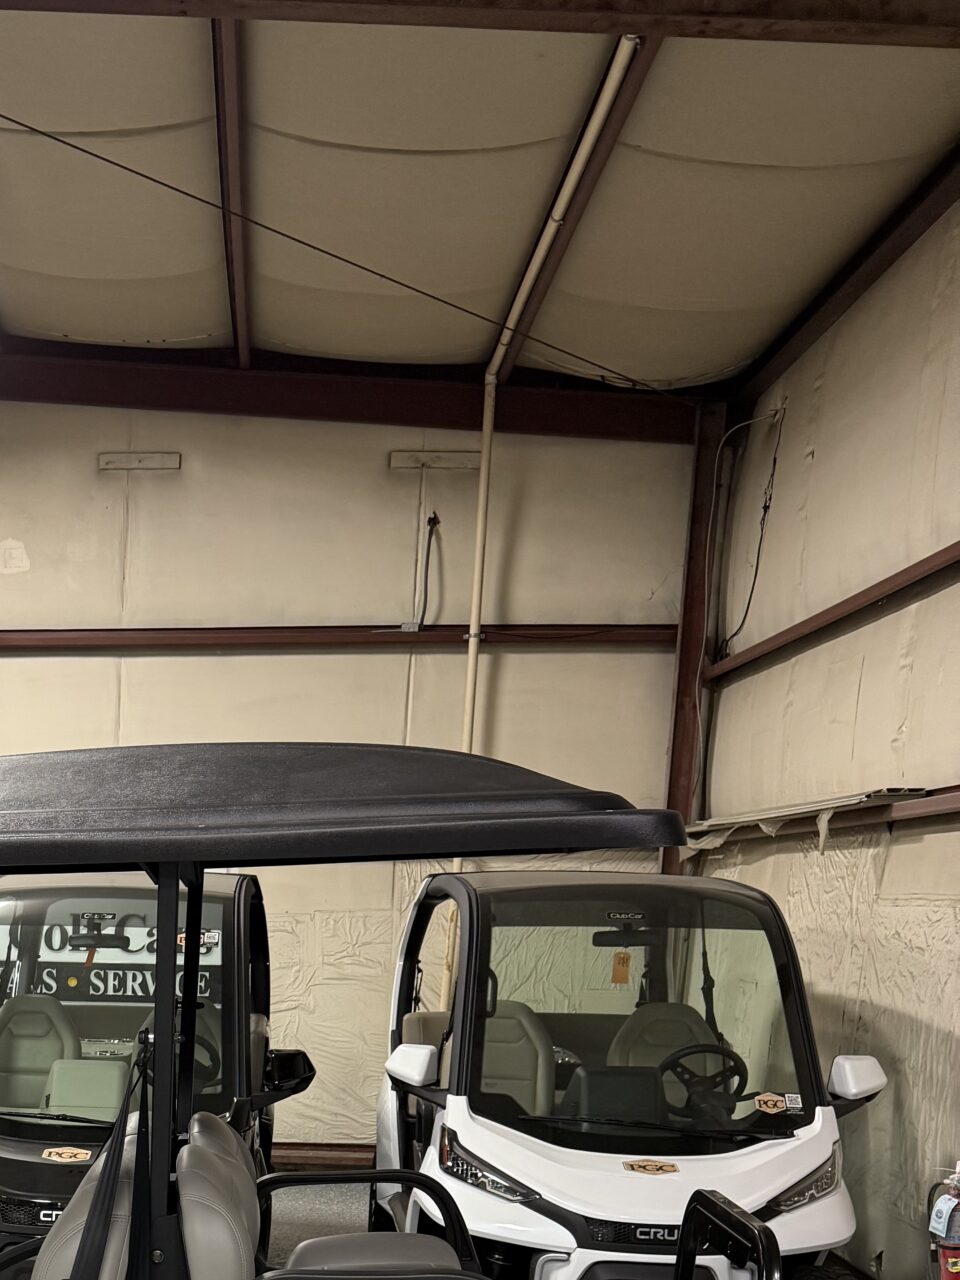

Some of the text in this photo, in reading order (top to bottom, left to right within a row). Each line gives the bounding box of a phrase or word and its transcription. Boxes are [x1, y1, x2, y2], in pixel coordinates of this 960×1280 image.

[758, 1099, 785, 1109] PGC
[47, 1151, 89, 1160] PGC
[629, 1163, 678, 1173] PGC
